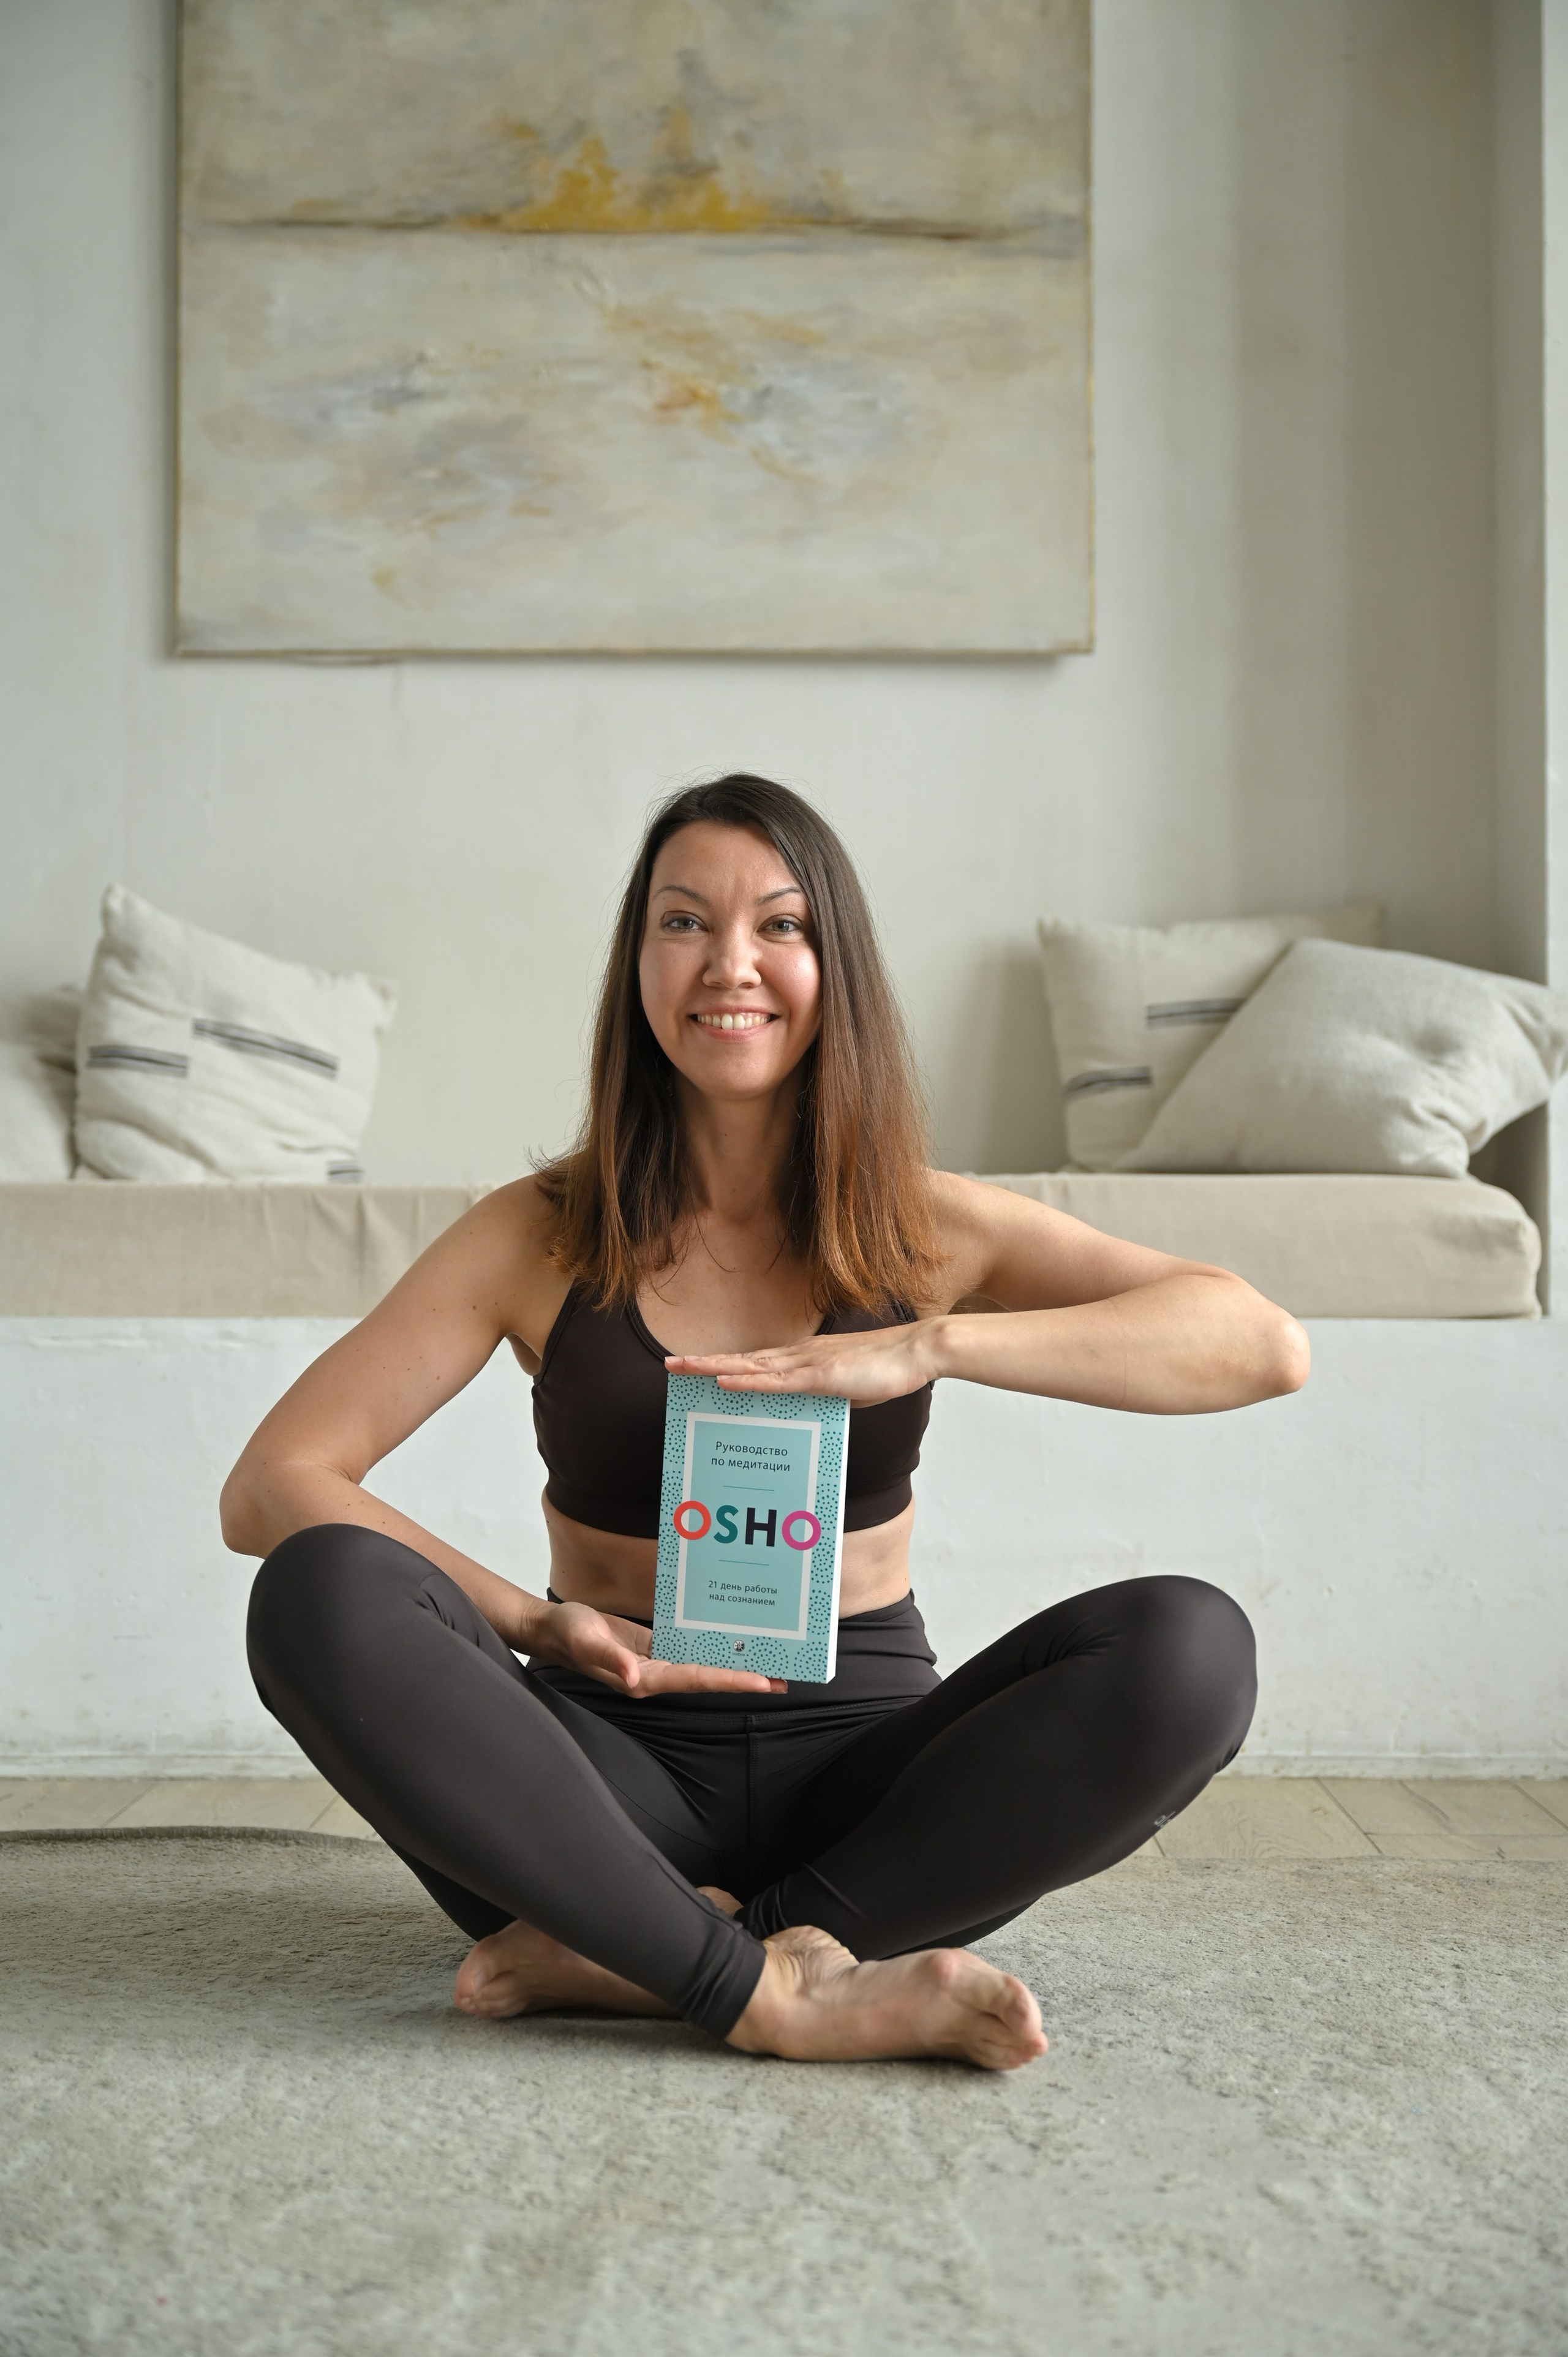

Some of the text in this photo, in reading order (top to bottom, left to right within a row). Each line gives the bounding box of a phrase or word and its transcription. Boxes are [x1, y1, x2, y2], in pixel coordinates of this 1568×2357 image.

[715, 1441, 788, 1456] Руководство
[728, 1459, 790, 1472] медитации
[673, 1500, 821, 1551] OSHO
[744, 1585, 777, 1594] работы
[728, 1595, 775, 1605] сознанием
